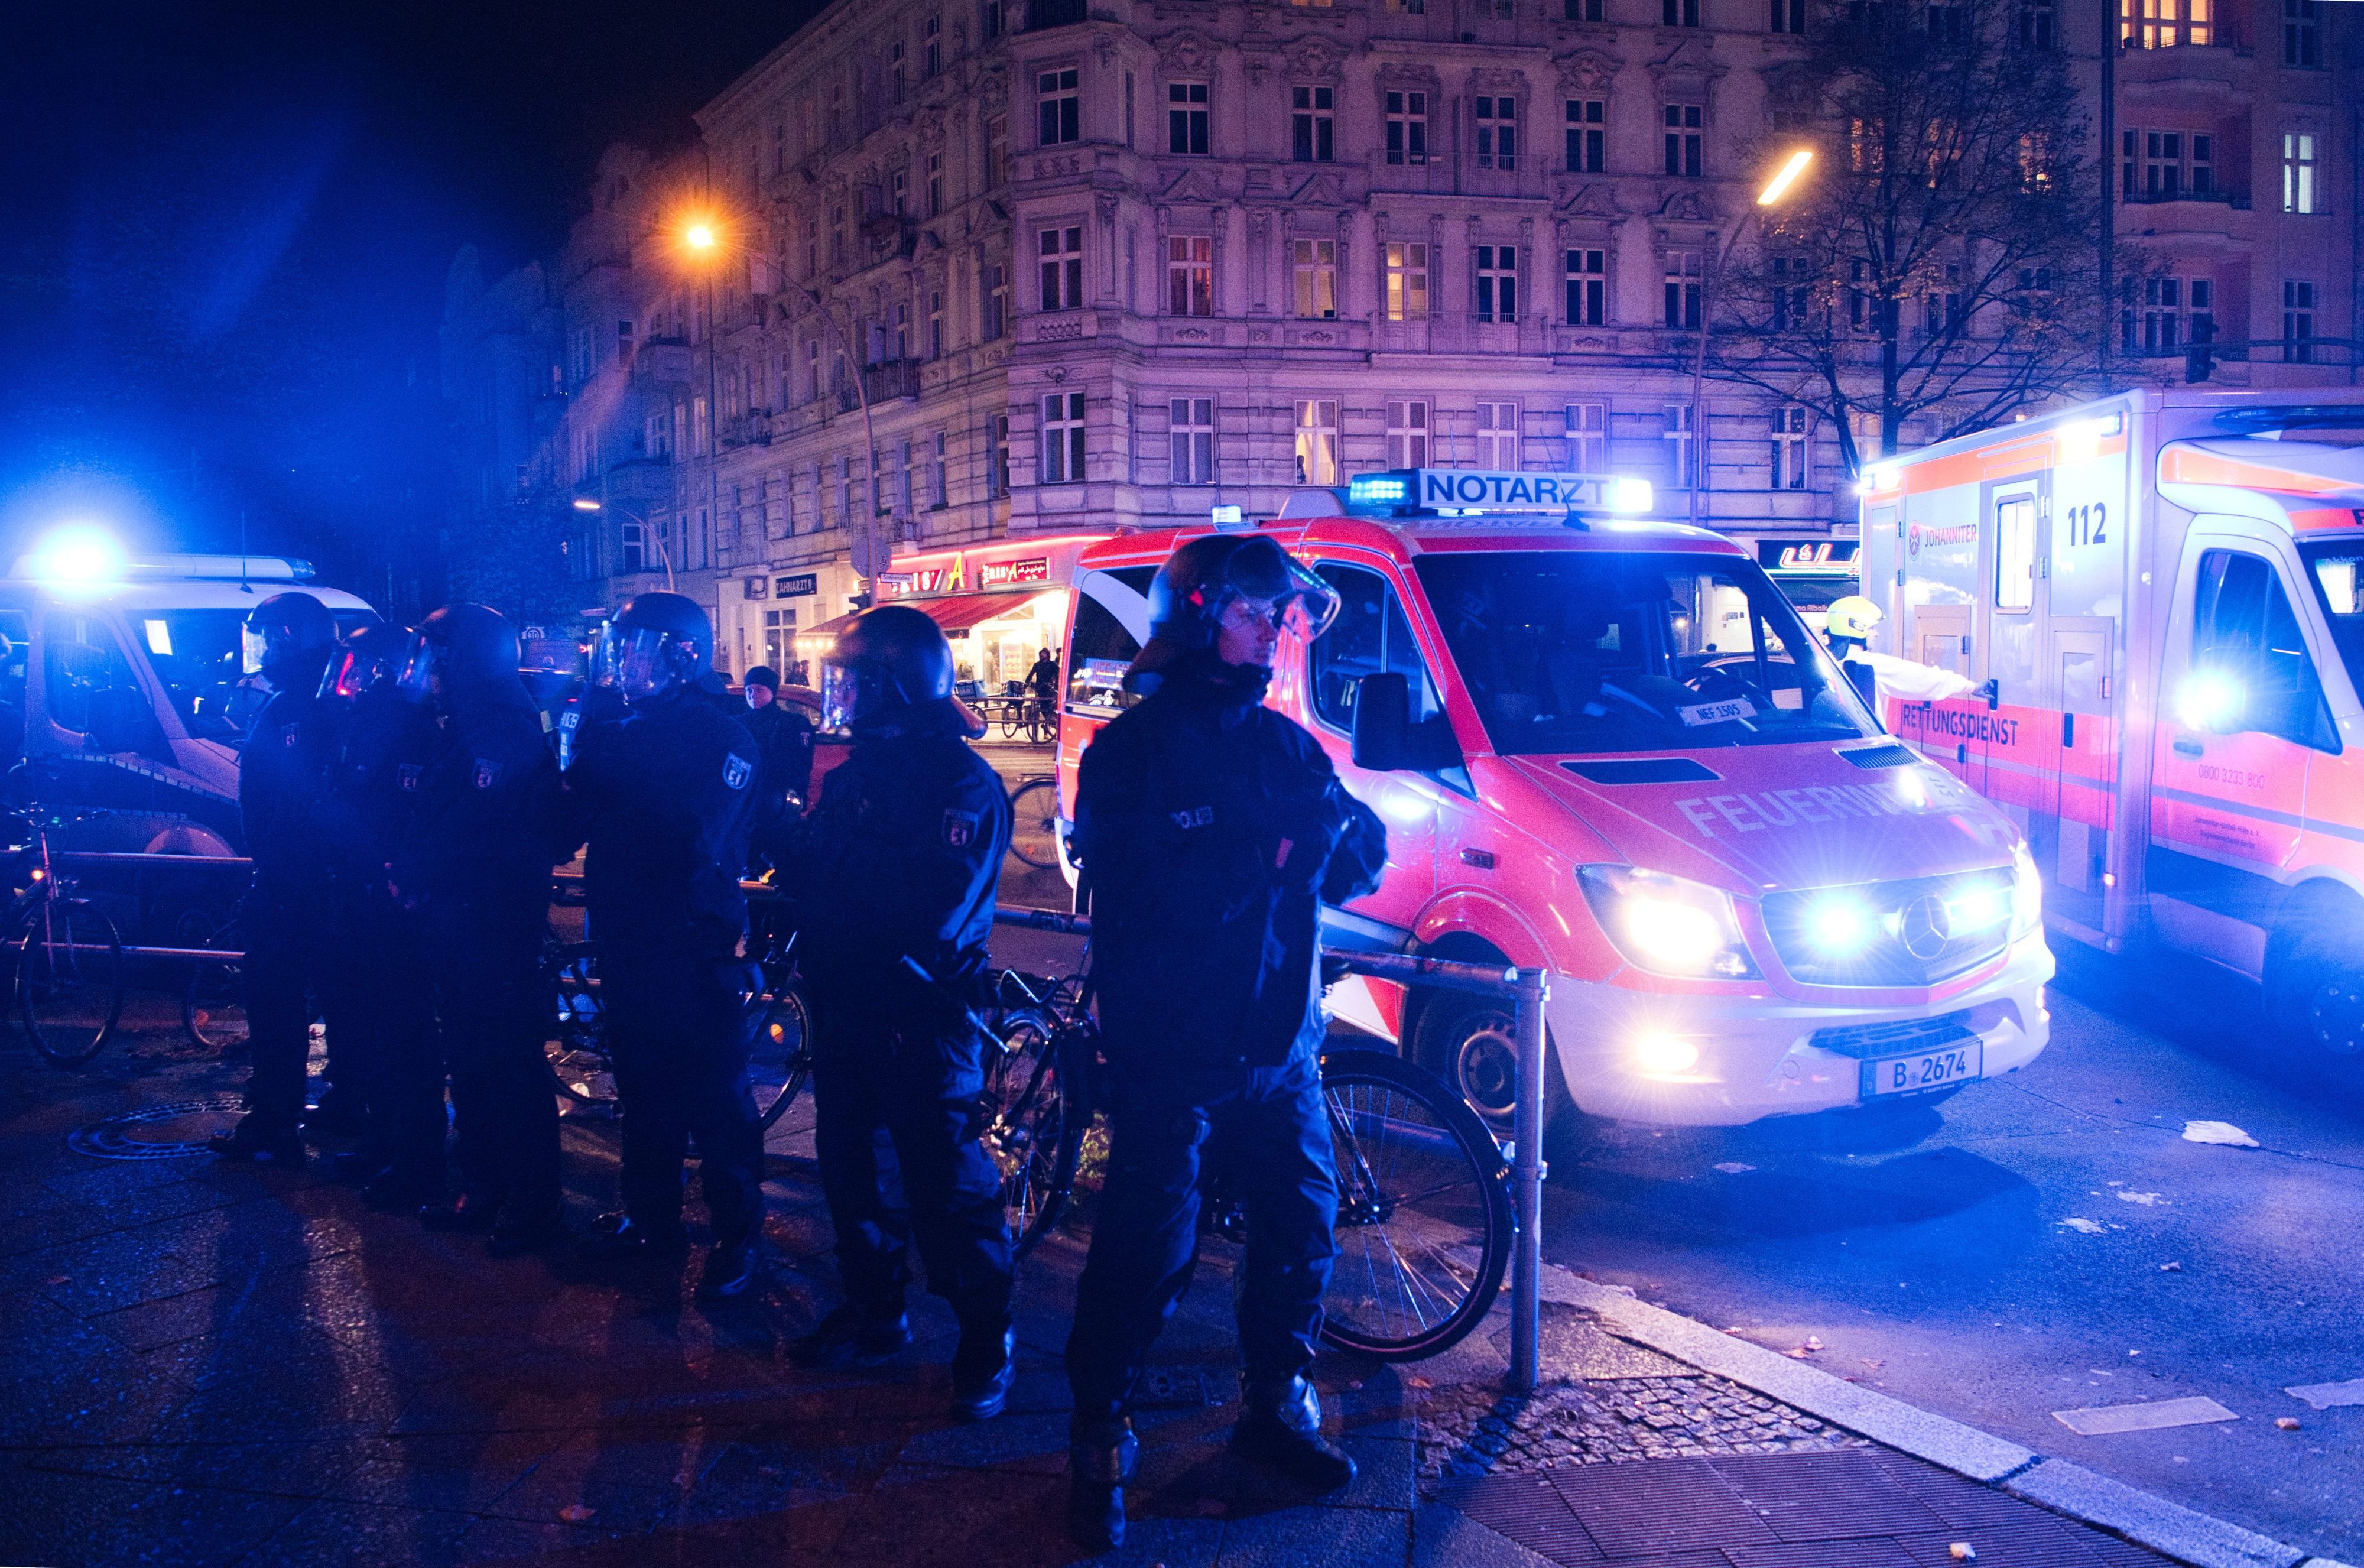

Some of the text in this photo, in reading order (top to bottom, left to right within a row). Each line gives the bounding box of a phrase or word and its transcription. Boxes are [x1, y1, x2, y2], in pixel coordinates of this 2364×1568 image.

[1427, 475, 1609, 504] NOTARZT
[1924, 524, 1977, 547] JOHANNITER
[2068, 502, 2106, 547] 112
[776, 579, 807, 594] ZAHNARZT
[1696, 707, 1714, 720] NEF
[1902, 704, 2019, 746] RETTUNGSDIENST
[2199, 764, 2265, 789] 0800 3233 800
[1894, 1049, 1966, 1087] B 2674
